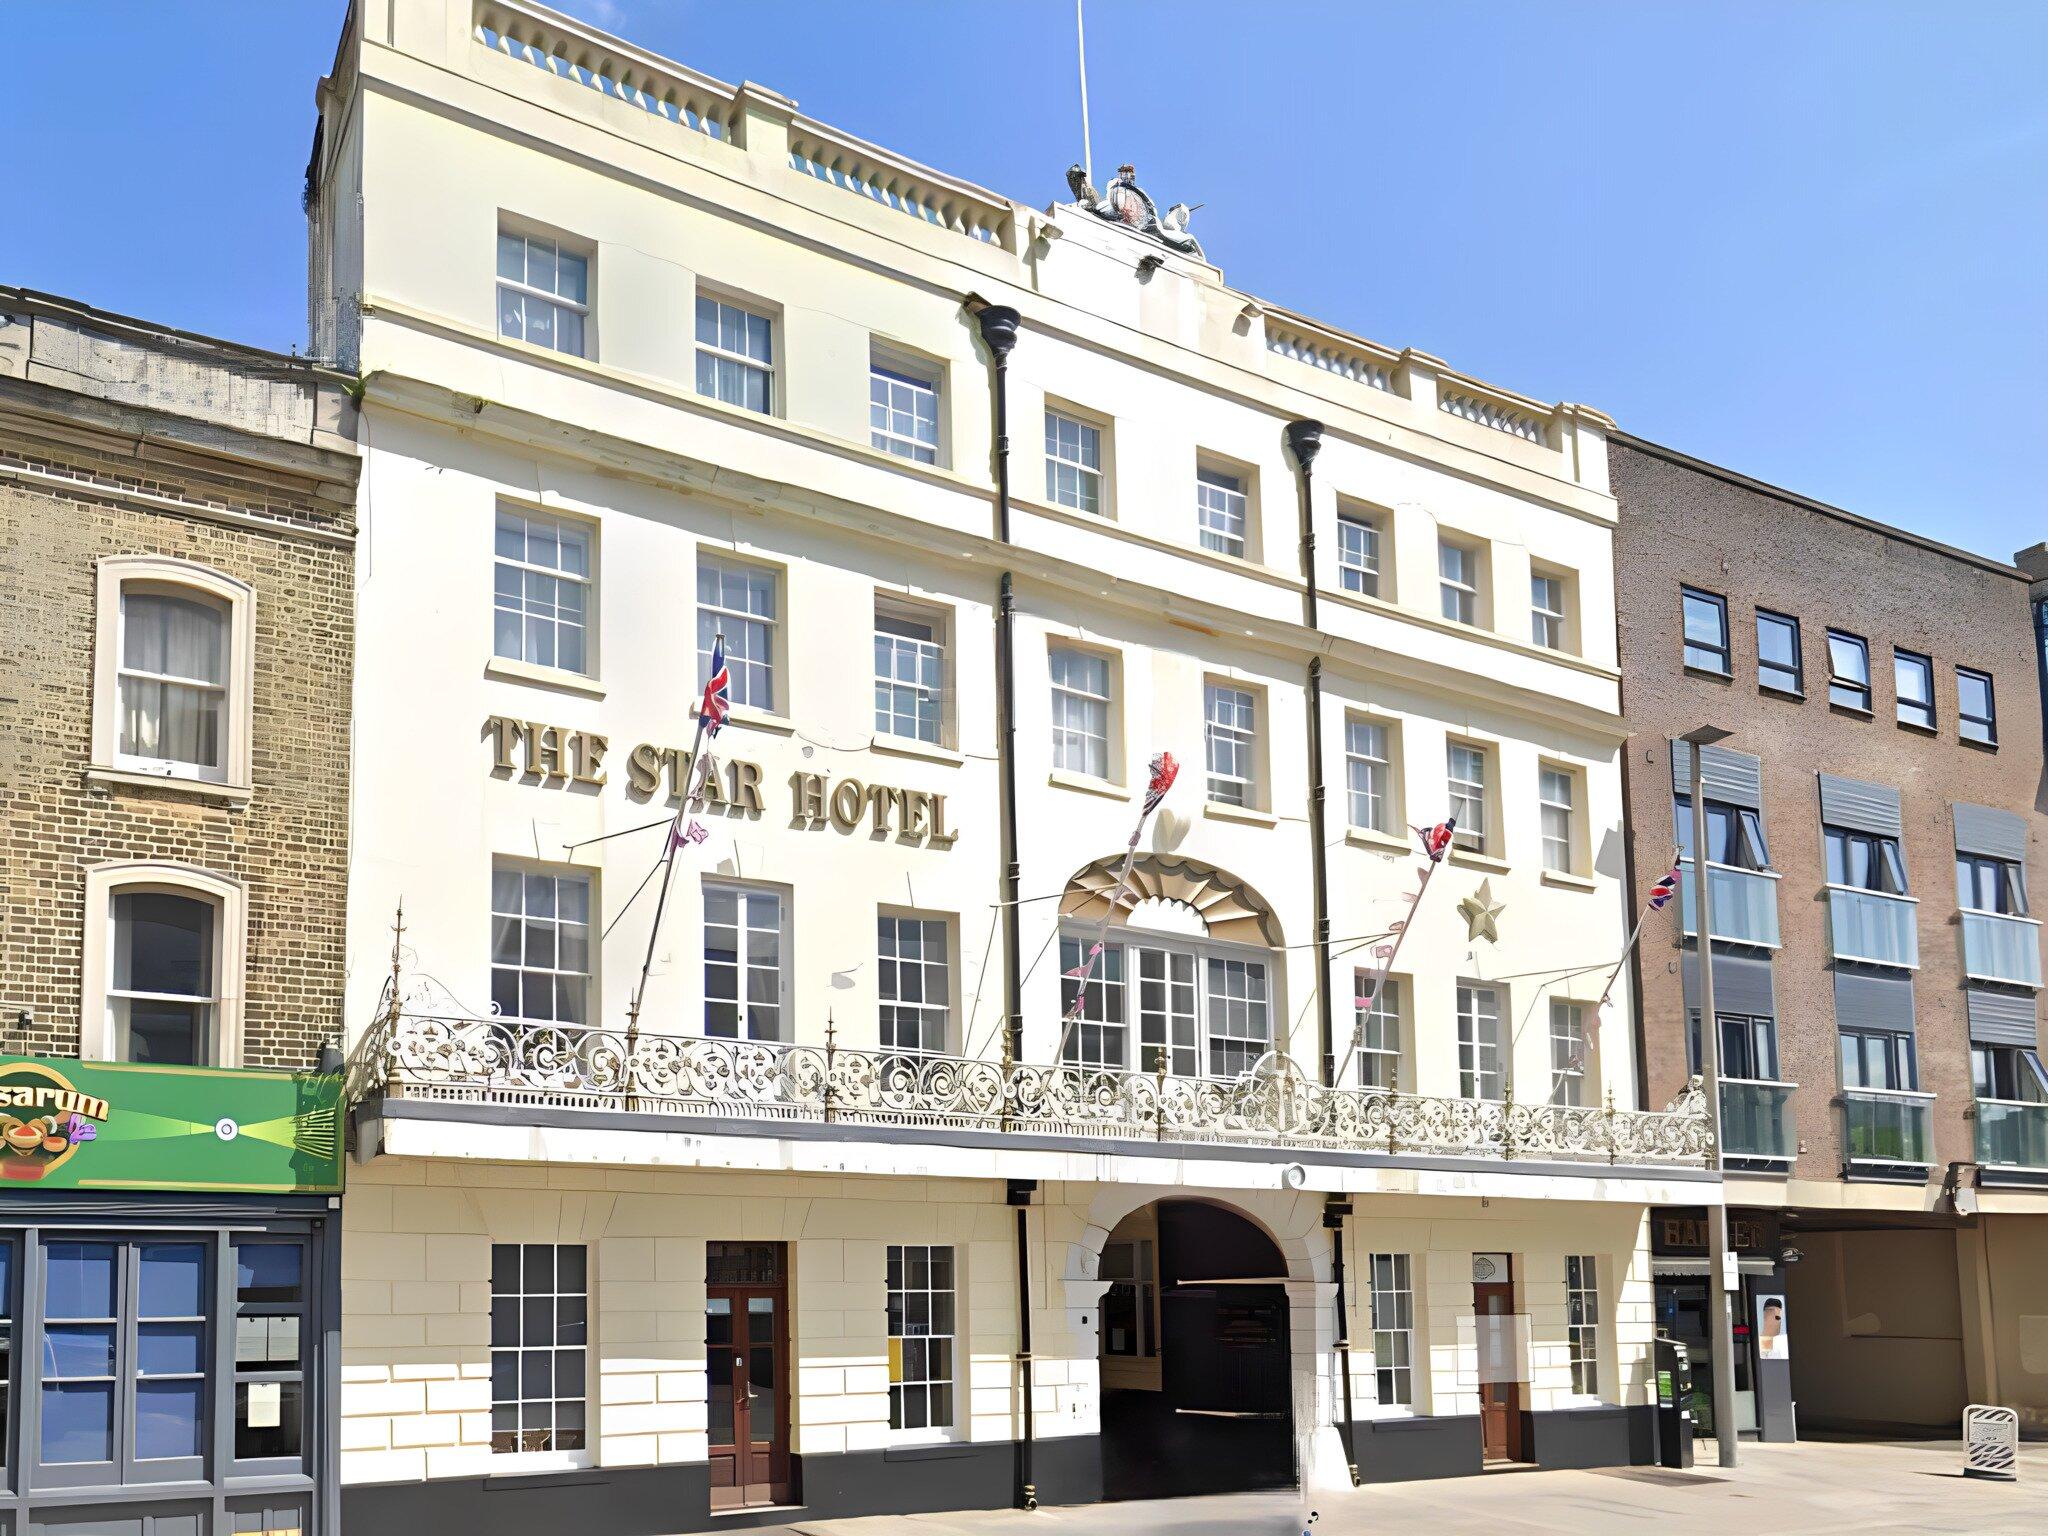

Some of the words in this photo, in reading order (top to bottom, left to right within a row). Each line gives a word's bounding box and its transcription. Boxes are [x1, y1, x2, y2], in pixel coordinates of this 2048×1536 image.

[486, 714, 609, 788] THE
[626, 742, 766, 812] STAR
[788, 770, 959, 844] HOTEL
